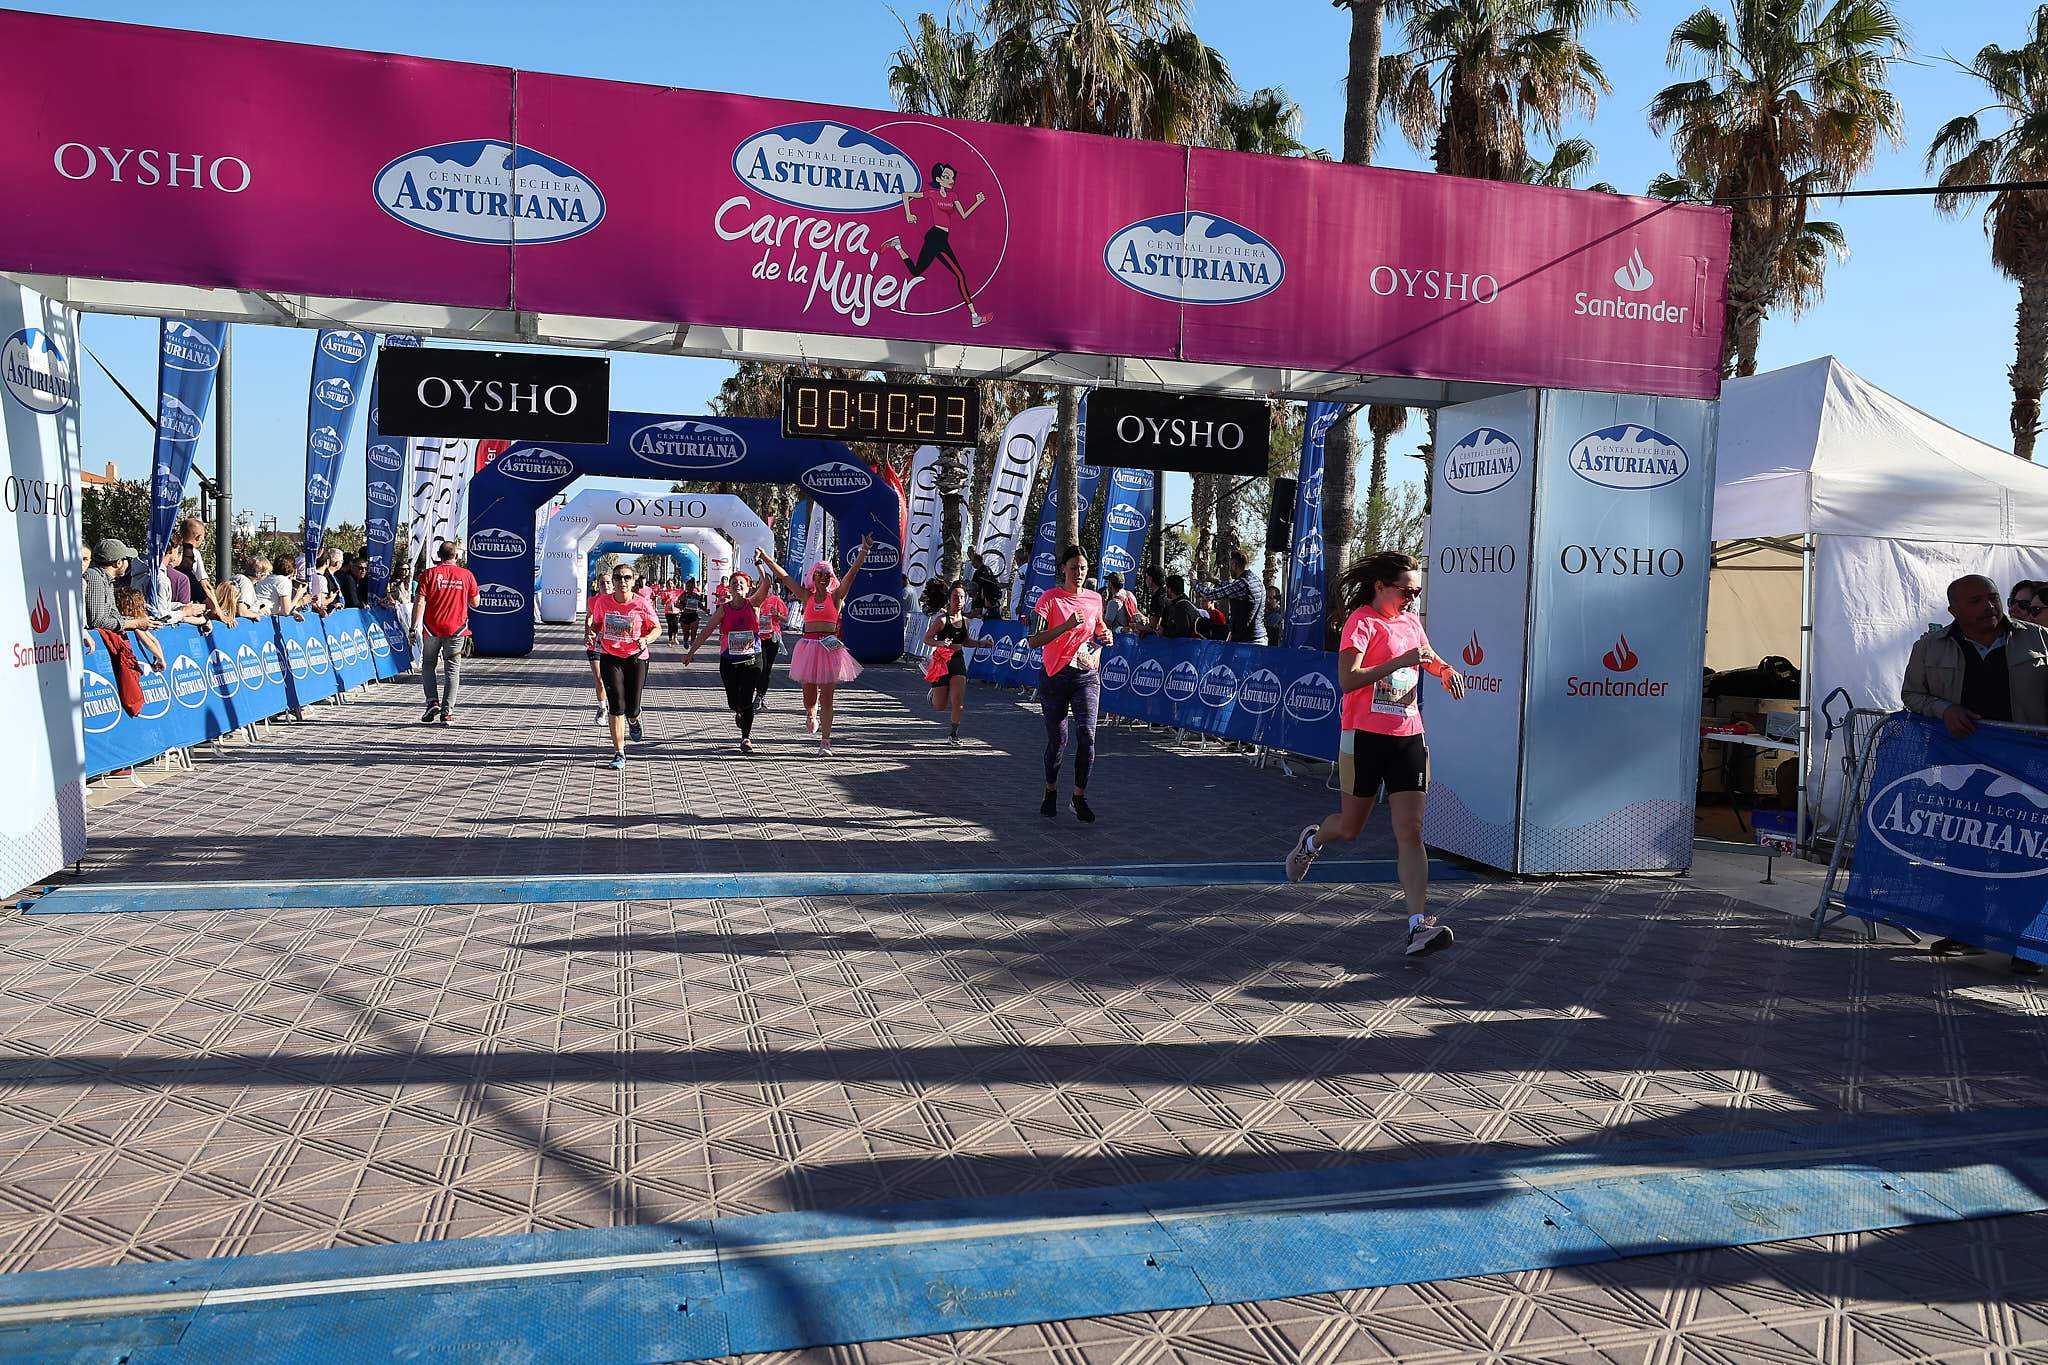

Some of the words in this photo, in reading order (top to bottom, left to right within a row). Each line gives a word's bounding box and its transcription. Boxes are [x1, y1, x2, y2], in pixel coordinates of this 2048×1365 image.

[53, 142, 251, 193] OYSHO
[747, 146, 905, 195] ASTURIANA
[777, 147, 837, 162] CENTRAL
[843, 154, 902, 169] LECHERA
[429, 170, 501, 187] CENTRAL
[391, 170, 588, 223] ASTURIANA
[714, 196, 870, 254] Carrera
[1117, 239, 1271, 285] ASTURIANA
[1147, 239, 1203, 253] CENTRAL
[1209, 244, 1266, 258] LECHERA
[752, 249, 781, 281] de
[787, 249, 808, 284] la
[803, 251, 926, 326] Mujer
[1369, 265, 1500, 304] OYSHO
[1574, 292, 1689, 323] Santander
[7, 349, 67, 398] ASTURIANA
[417, 376, 578, 416] OYSHO
[797, 387, 966, 436] 00:40:23
[638, 432, 738, 458] ASTURIANA
[1116, 415, 1244, 451] OYSHO
[1576, 445, 1680, 476] ASTURIANA
[1597, 445, 1635, 454] CENTRAL
[1637, 448, 1677, 456] LECHERA
[502, 458, 568, 474] ASTURIANA
[807, 473, 868, 488] ASTURIANA
[1448, 455, 1515, 481] ASTURIANA
[4, 475, 73, 518] OYSHO
[615, 497, 707, 519] OYSHO
[981, 433, 1037, 578] OYSHO
[731, 520, 759, 528] OYSHO
[471, 538, 523, 553] ASTURIANA
[850, 552, 897, 564] ATURIANA
[1440, 544, 1516, 574] OYSHO
[1560, 544, 1685, 578] OYSHO
[851, 605, 900, 616] ASTURIANA
[13, 639, 70, 668] Santander
[1240, 683, 1278, 704] ASTURIANA
[1286, 687, 1332, 712] ASTURIANA
[1566, 676, 1669, 698] Santander
[1916, 792, 1981, 813] CENTRAL
